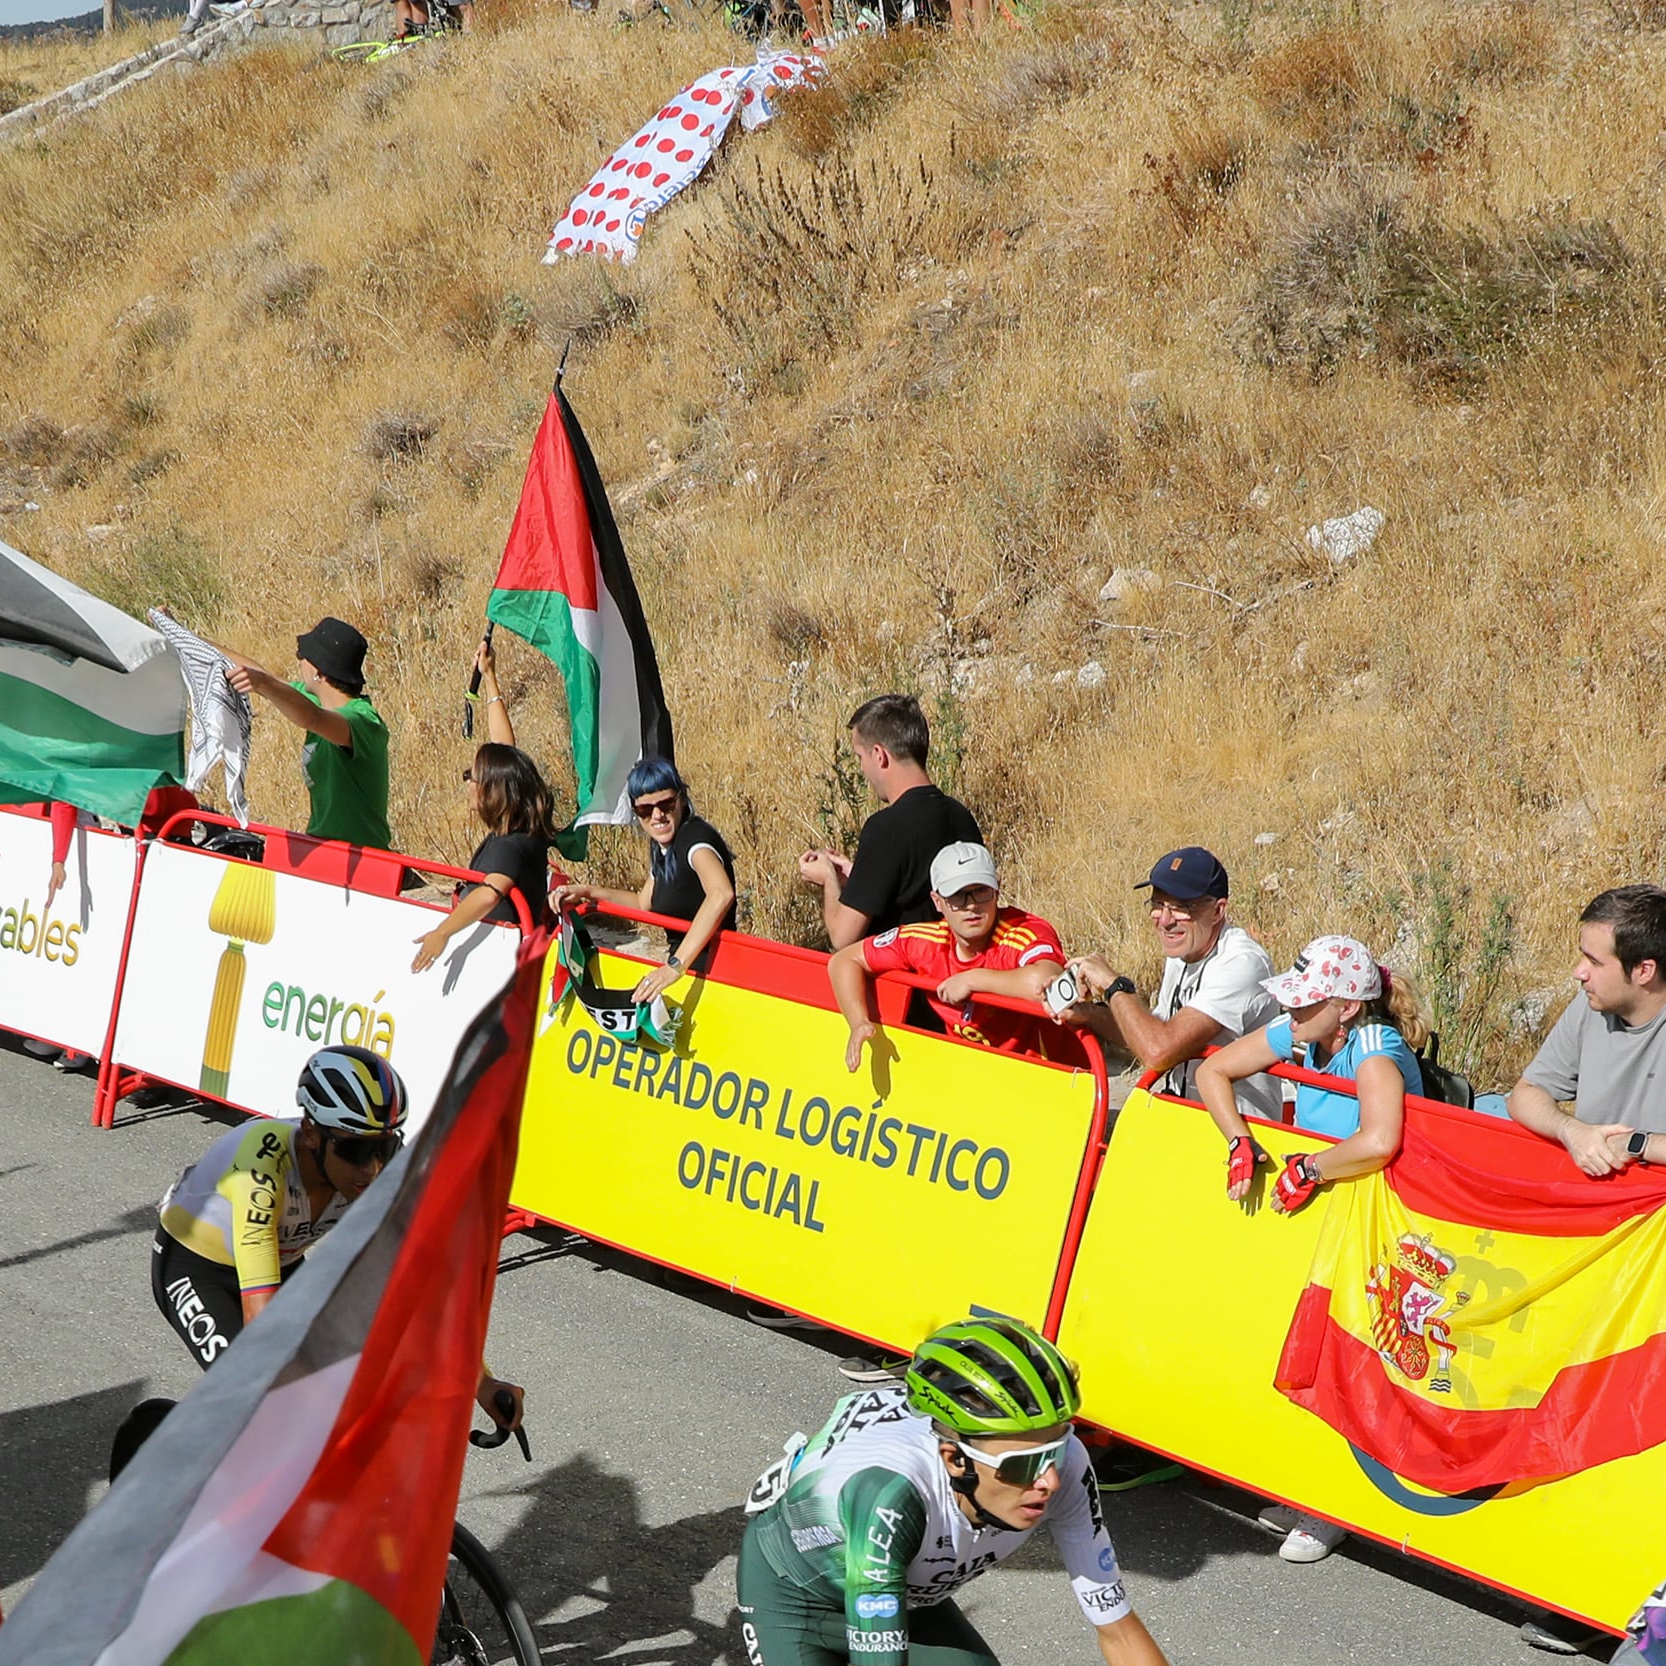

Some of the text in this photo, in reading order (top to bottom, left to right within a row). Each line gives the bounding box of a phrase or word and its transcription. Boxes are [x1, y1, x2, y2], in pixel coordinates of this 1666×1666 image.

[565, 1028, 1011, 1201] OPERADOR LOGÍSTICO
[241, 1167, 279, 1247] INEOS
[677, 1140, 826, 1234] OFICIAL
[165, 1275, 229, 1362] INEOS
[918, 1384, 960, 1427] Spiuk
[862, 1504, 903, 1583] ALEA
[857, 1601, 897, 1612] KMC
